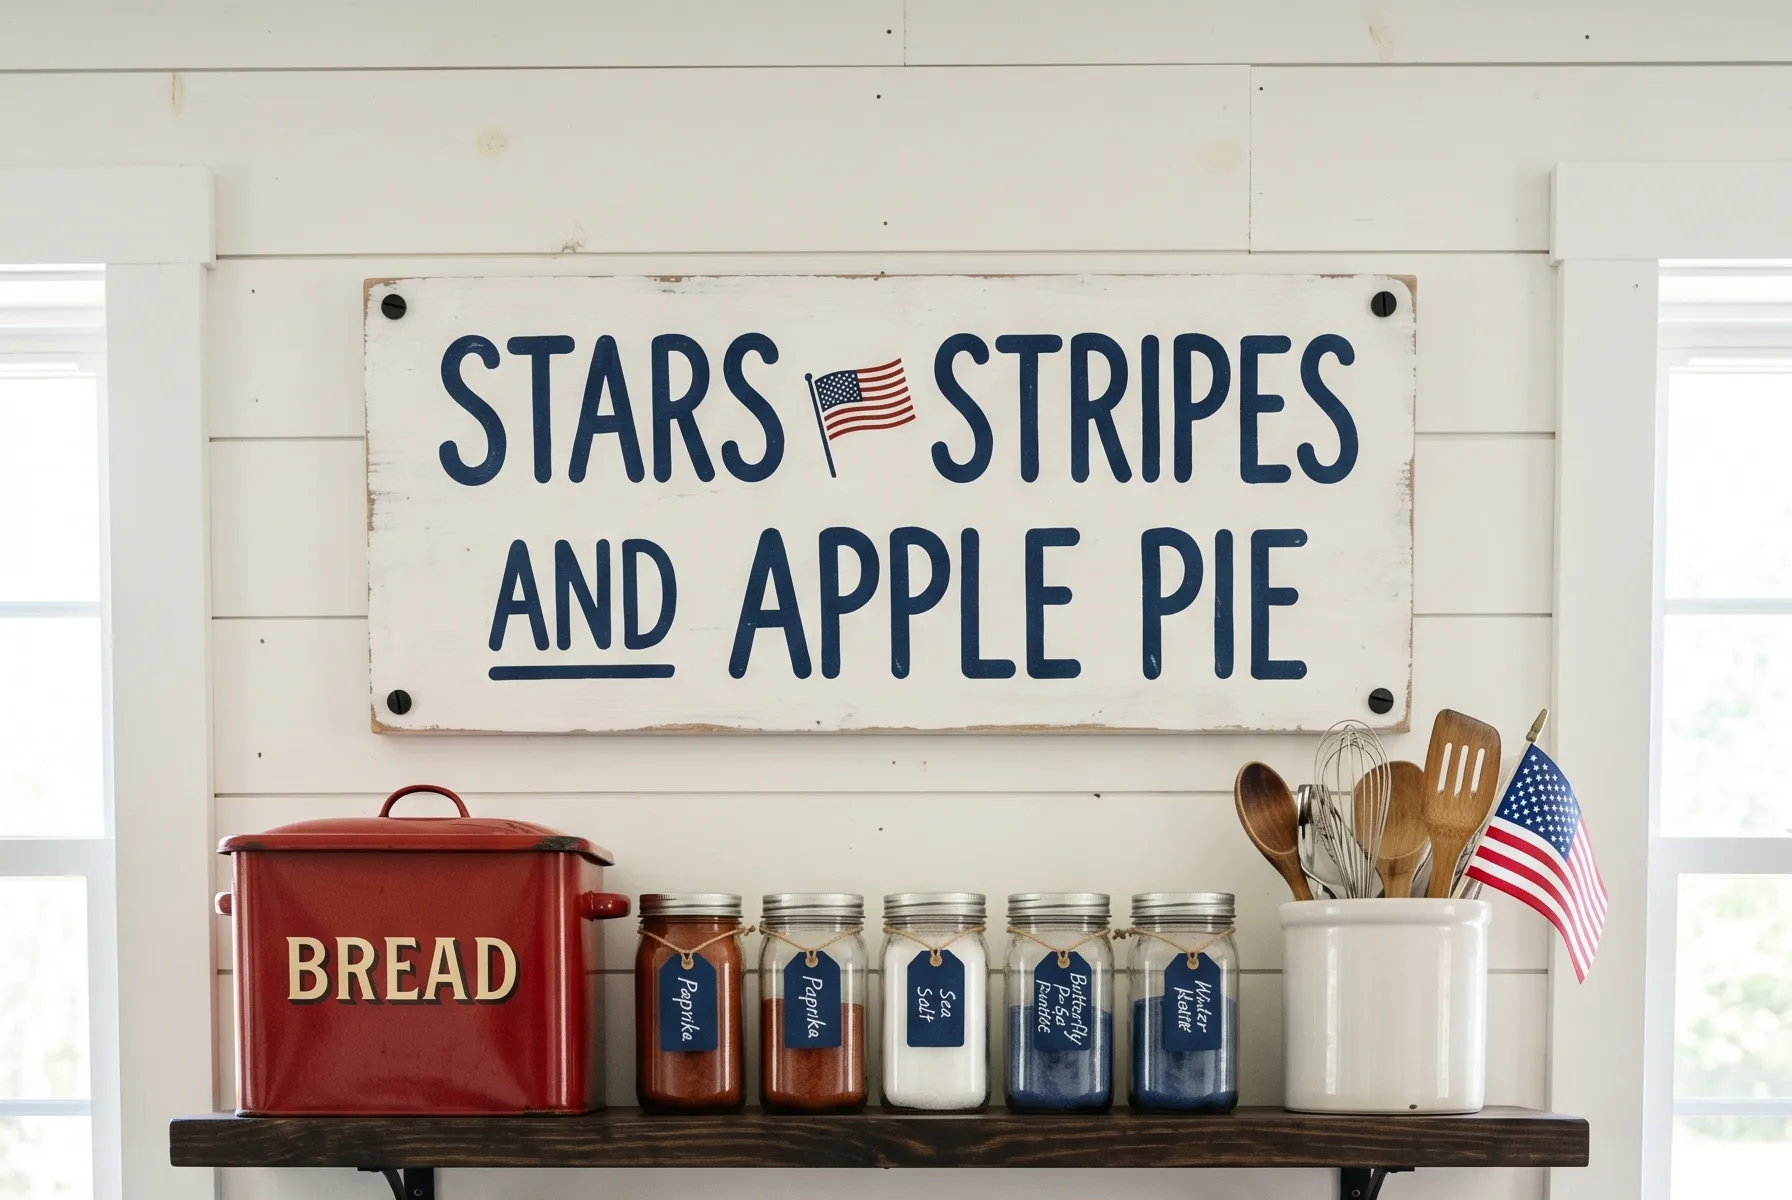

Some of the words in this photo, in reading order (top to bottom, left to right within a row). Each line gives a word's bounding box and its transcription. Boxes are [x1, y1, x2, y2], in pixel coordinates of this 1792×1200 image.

[438, 332, 785, 487] STARS
[931, 332, 1359, 485] STRIPES
[488, 538, 677, 652] AND
[728, 526, 1082, 680] APPLE
[1140, 526, 1308, 680] PIE
[285, 936, 520, 1004] BREAD
[939, 988, 957, 1018] Sea
[671, 976, 701, 1042] Paprika
[798, 975, 827, 1039] Paprika
[916, 986, 936, 1023] Salt
